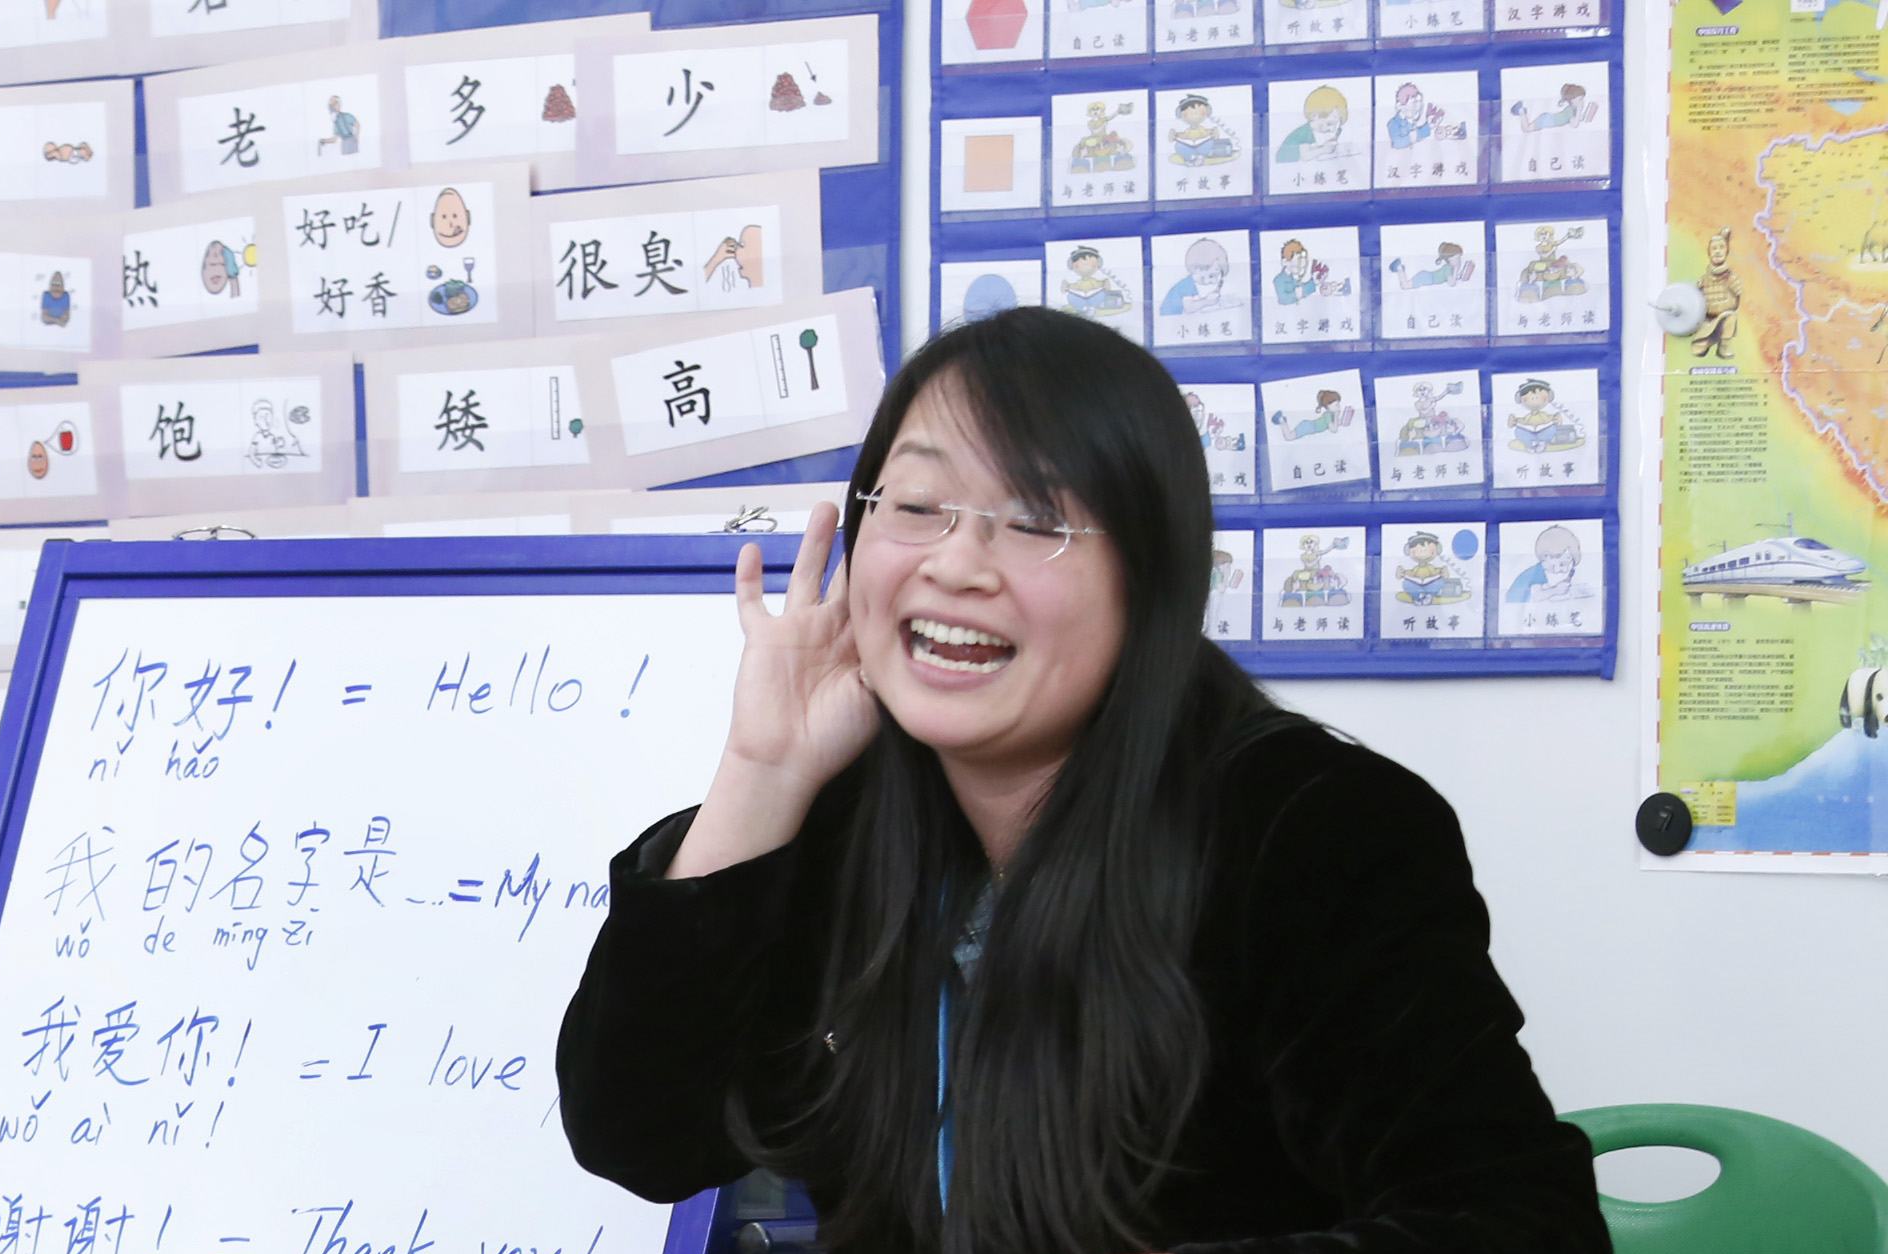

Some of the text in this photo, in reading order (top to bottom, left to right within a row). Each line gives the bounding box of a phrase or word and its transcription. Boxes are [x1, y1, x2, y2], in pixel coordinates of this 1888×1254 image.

[447, 75, 486, 145] 多
[664, 69, 714, 136] 少
[218, 107, 266, 168] 老
[296, 202, 401, 250] 好吃/
[122, 250, 158, 307] 热
[314, 272, 397, 318] 好香
[556, 230, 688, 300] 很臭
[434, 390, 488, 451] 矮
[663, 360, 711, 427] 高
[150, 401, 202, 462] 饱
[91, 647, 297, 740] 你好!
[496, 854, 551, 940] My
[565, 880, 609, 909] na
[144, 919, 176, 955] de
[23, 997, 251, 1087] 我爱你!
[347, 1023, 387, 1080] I
[428, 1024, 527, 1091] love
